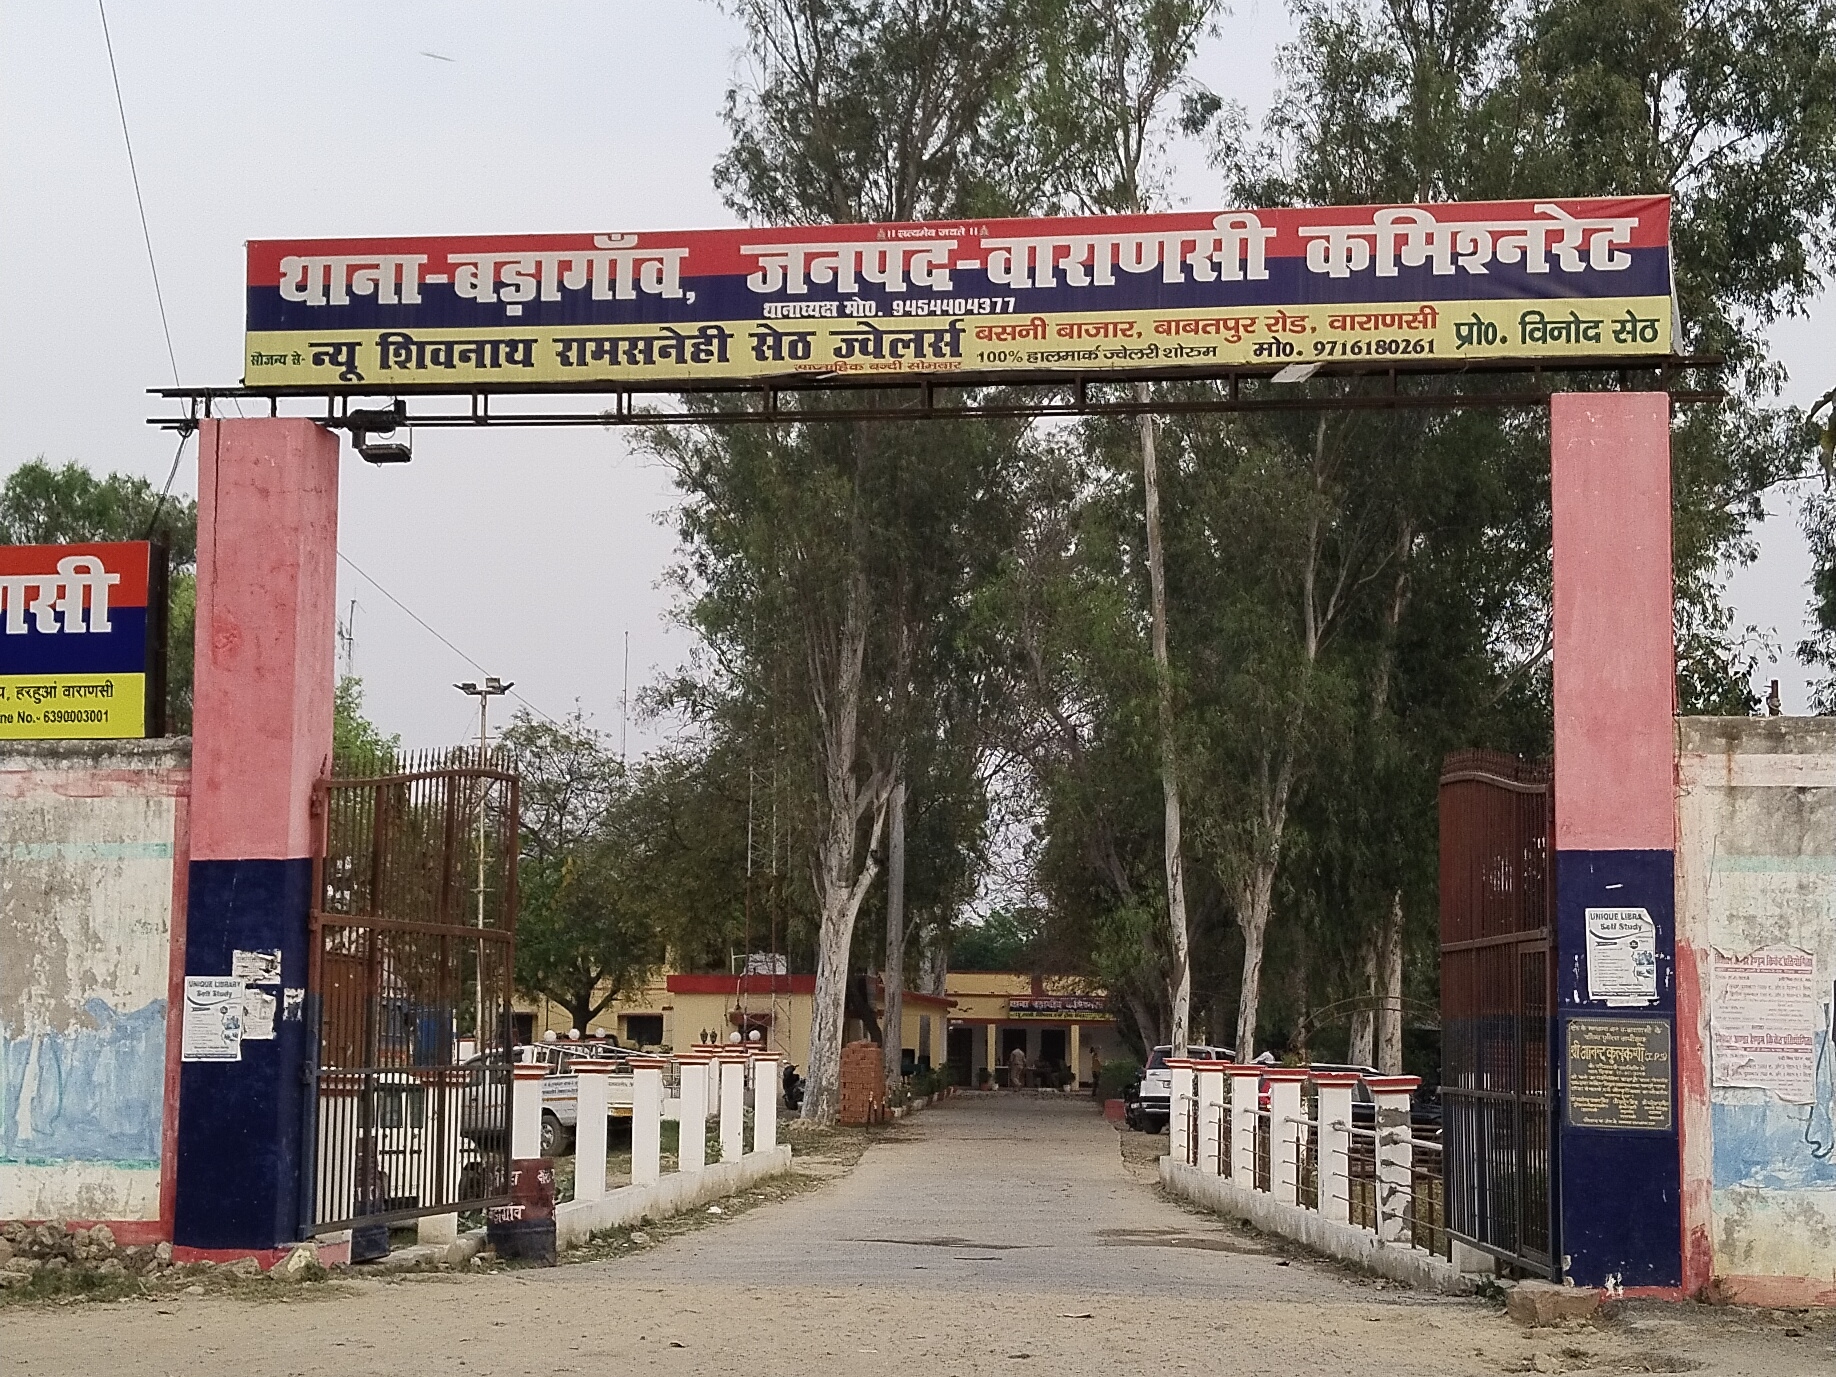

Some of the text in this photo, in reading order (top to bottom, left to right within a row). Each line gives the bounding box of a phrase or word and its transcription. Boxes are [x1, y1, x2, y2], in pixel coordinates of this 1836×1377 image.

[938, 226, 965, 237] जयते
[740, 213, 1276, 294] जनपद-वाराणसी
[1298, 204, 1639, 278] कमिश्नरेट
[763, 302, 837, 319] थानाध्यक्ष
[891, 298, 1016, 316] 9454404377
[974, 304, 1440, 344] बसनी बाजार, बाबतपुर रोड, वाराणसी
[1518, 310, 1604, 345] विनोद
[1611, 309, 1661, 344] सेठ
[250, 351, 287, 366] सौजन्य
[308, 341, 364, 383] न्यू
[375, 331, 539, 371] शिवनाथ
[552, 324, 735, 368] रामसनेही
[747, 323, 817, 363] सेठ
[829, 318, 967, 361] ज्वेलर्स
[977, 349, 1023, 364] 100%
[1026, 344, 1101, 363] हालमार्क
[1312, 338, 1436, 357] 9716180261
[907, 360, 961, 371] सोमवार
[62, 680, 114, 698] वाराणसी
[43, 709, 109, 724] 6390003001
[1590, 912, 1619, 921] UNIQUE
[1618, 923, 1643, 932] Study
[188, 980, 241, 988] UNIQUE LIBRARY
[212, 990, 232, 998] Study
